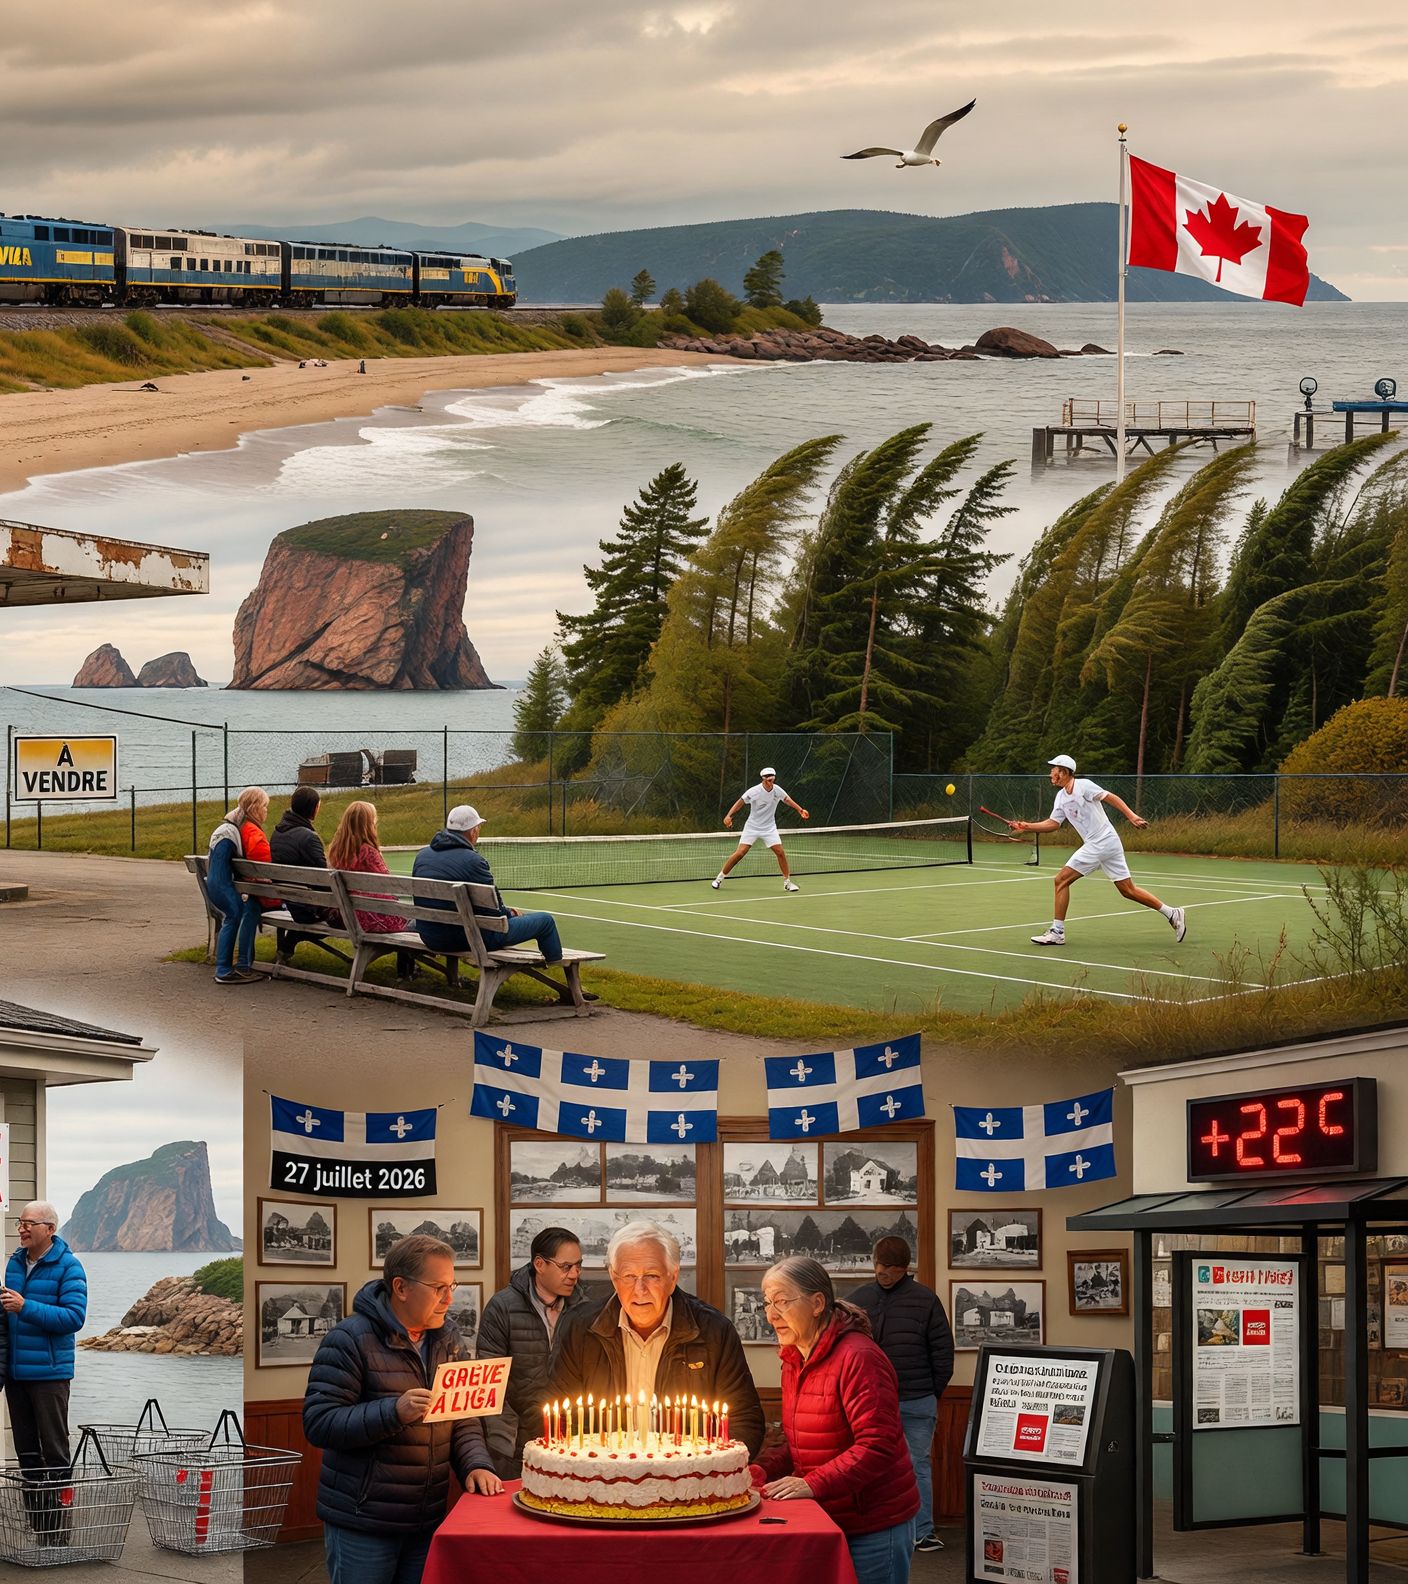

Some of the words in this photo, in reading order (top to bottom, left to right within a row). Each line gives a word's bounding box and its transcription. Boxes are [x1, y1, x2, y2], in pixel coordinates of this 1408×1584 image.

[22, 770, 108, 793] VENDRE
[284, 1161, 310, 1185] 27
[313, 1163, 373, 1192] juillet
[378, 1167, 426, 1190] 2026
